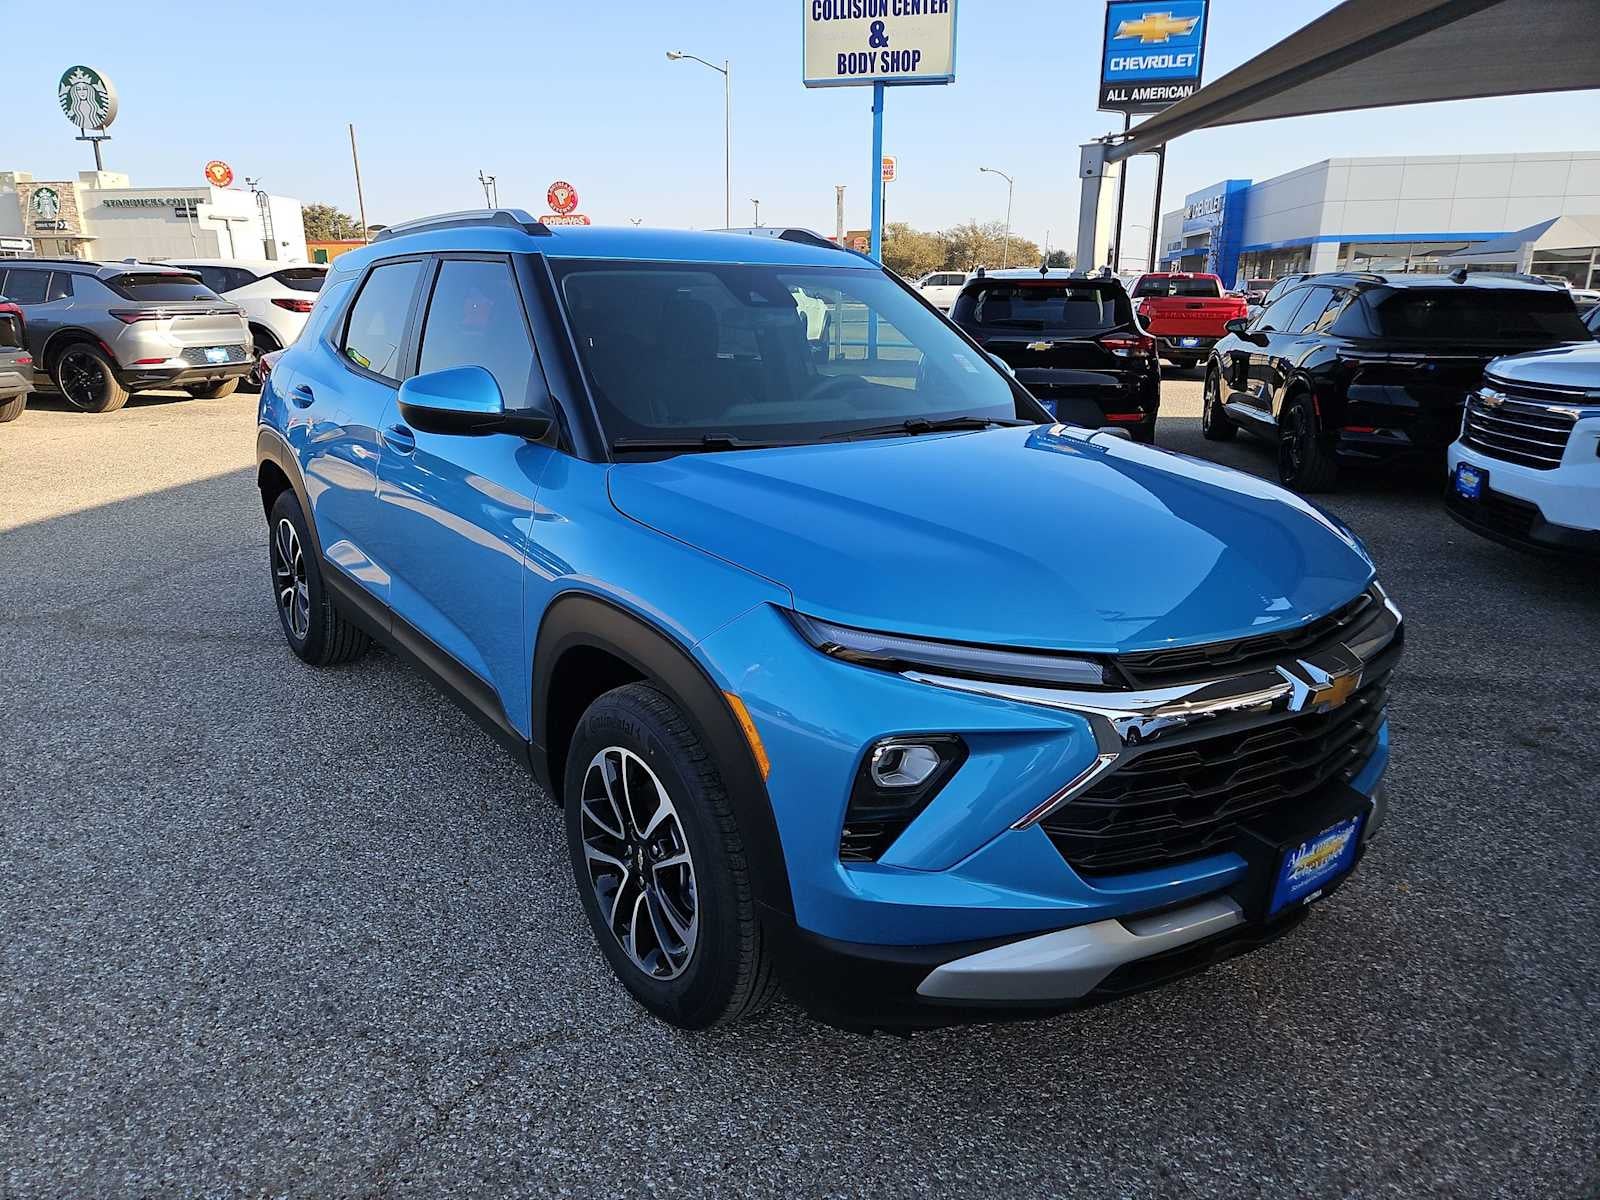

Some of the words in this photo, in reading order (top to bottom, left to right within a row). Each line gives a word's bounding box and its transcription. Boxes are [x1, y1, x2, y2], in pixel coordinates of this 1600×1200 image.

[812, 0, 888, 21] COLLISION
[892, 0, 948, 16] CENTER
[868, 20, 889, 48] &
[837, 52, 877, 75] BODY
[880, 50, 921, 73] SHOP
[1110, 53, 1195, 71] CHEVROLET
[1106, 89, 1129, 102] ALL
[1131, 85, 1194, 101] AMERICAN
